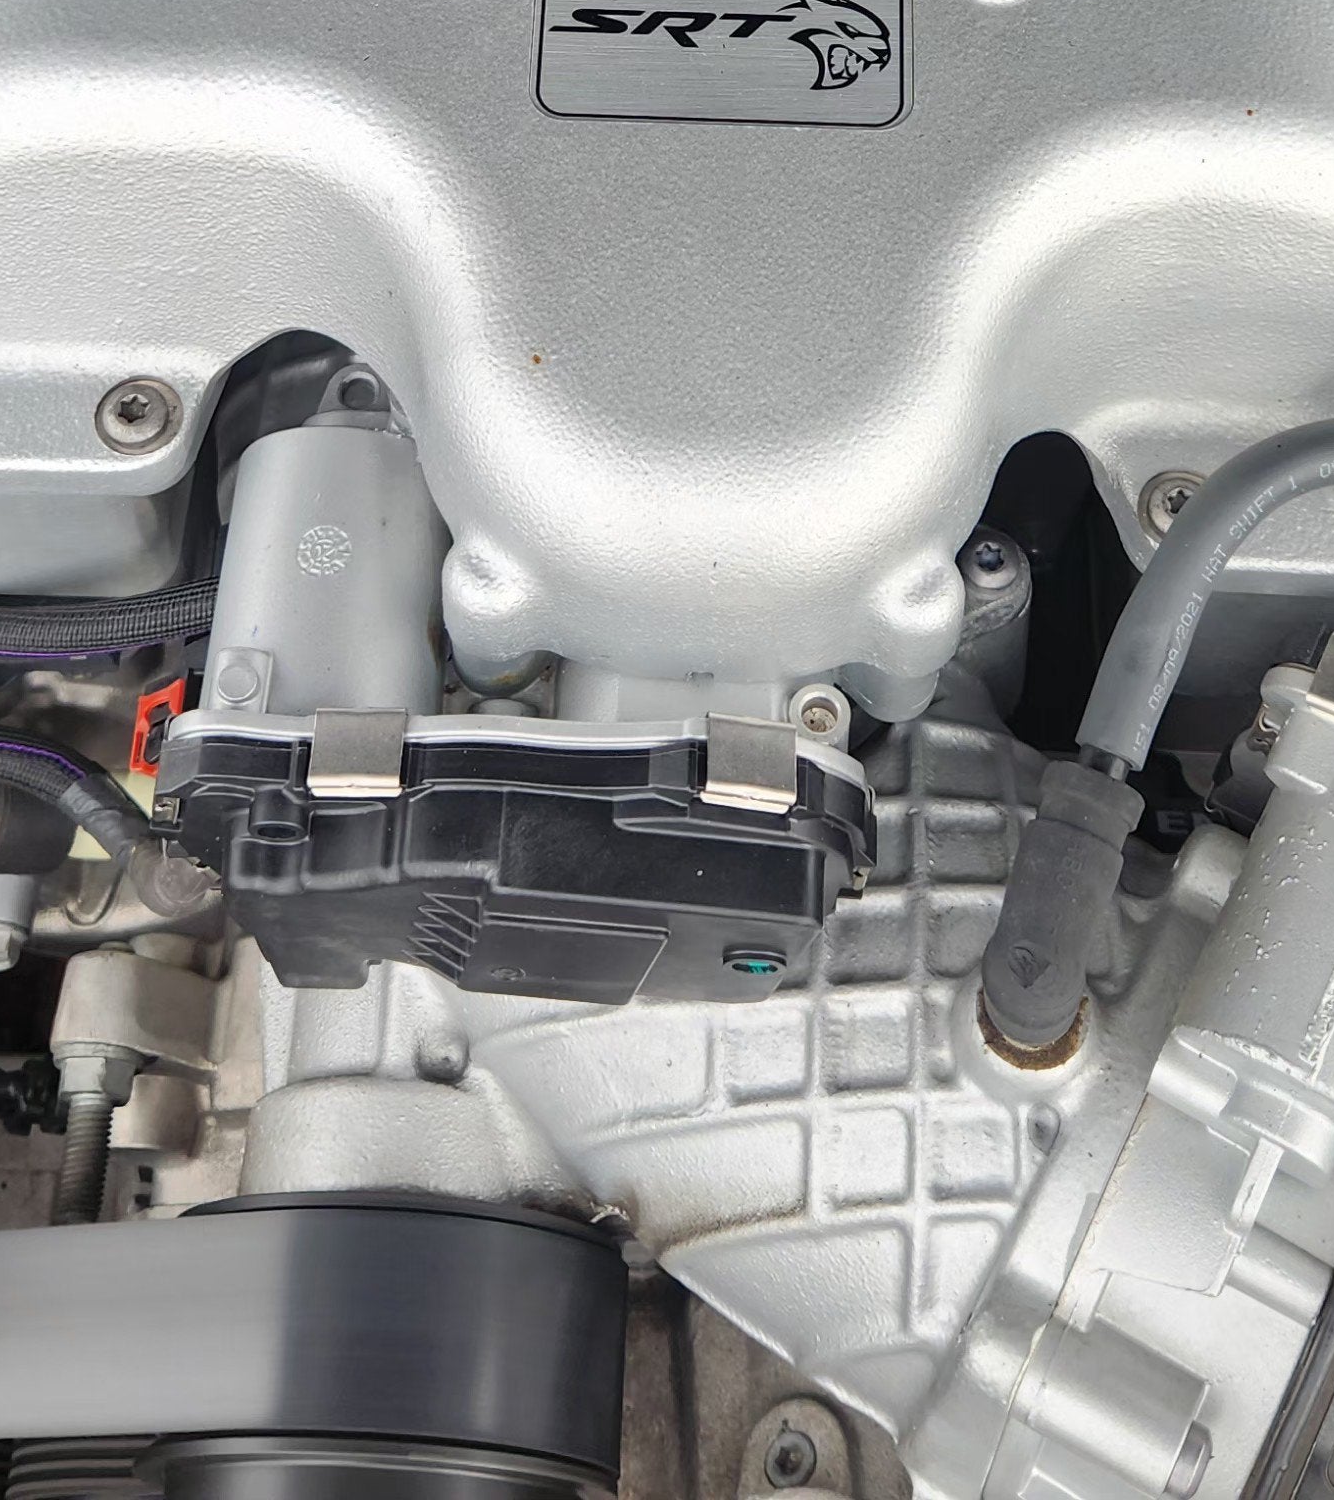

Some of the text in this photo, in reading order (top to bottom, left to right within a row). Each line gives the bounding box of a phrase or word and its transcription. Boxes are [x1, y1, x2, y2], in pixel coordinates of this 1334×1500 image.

[548, 8, 797, 48] SRT
[1201, 544, 1227, 583] HAT
[1229, 485, 1275, 540] SHIFT
